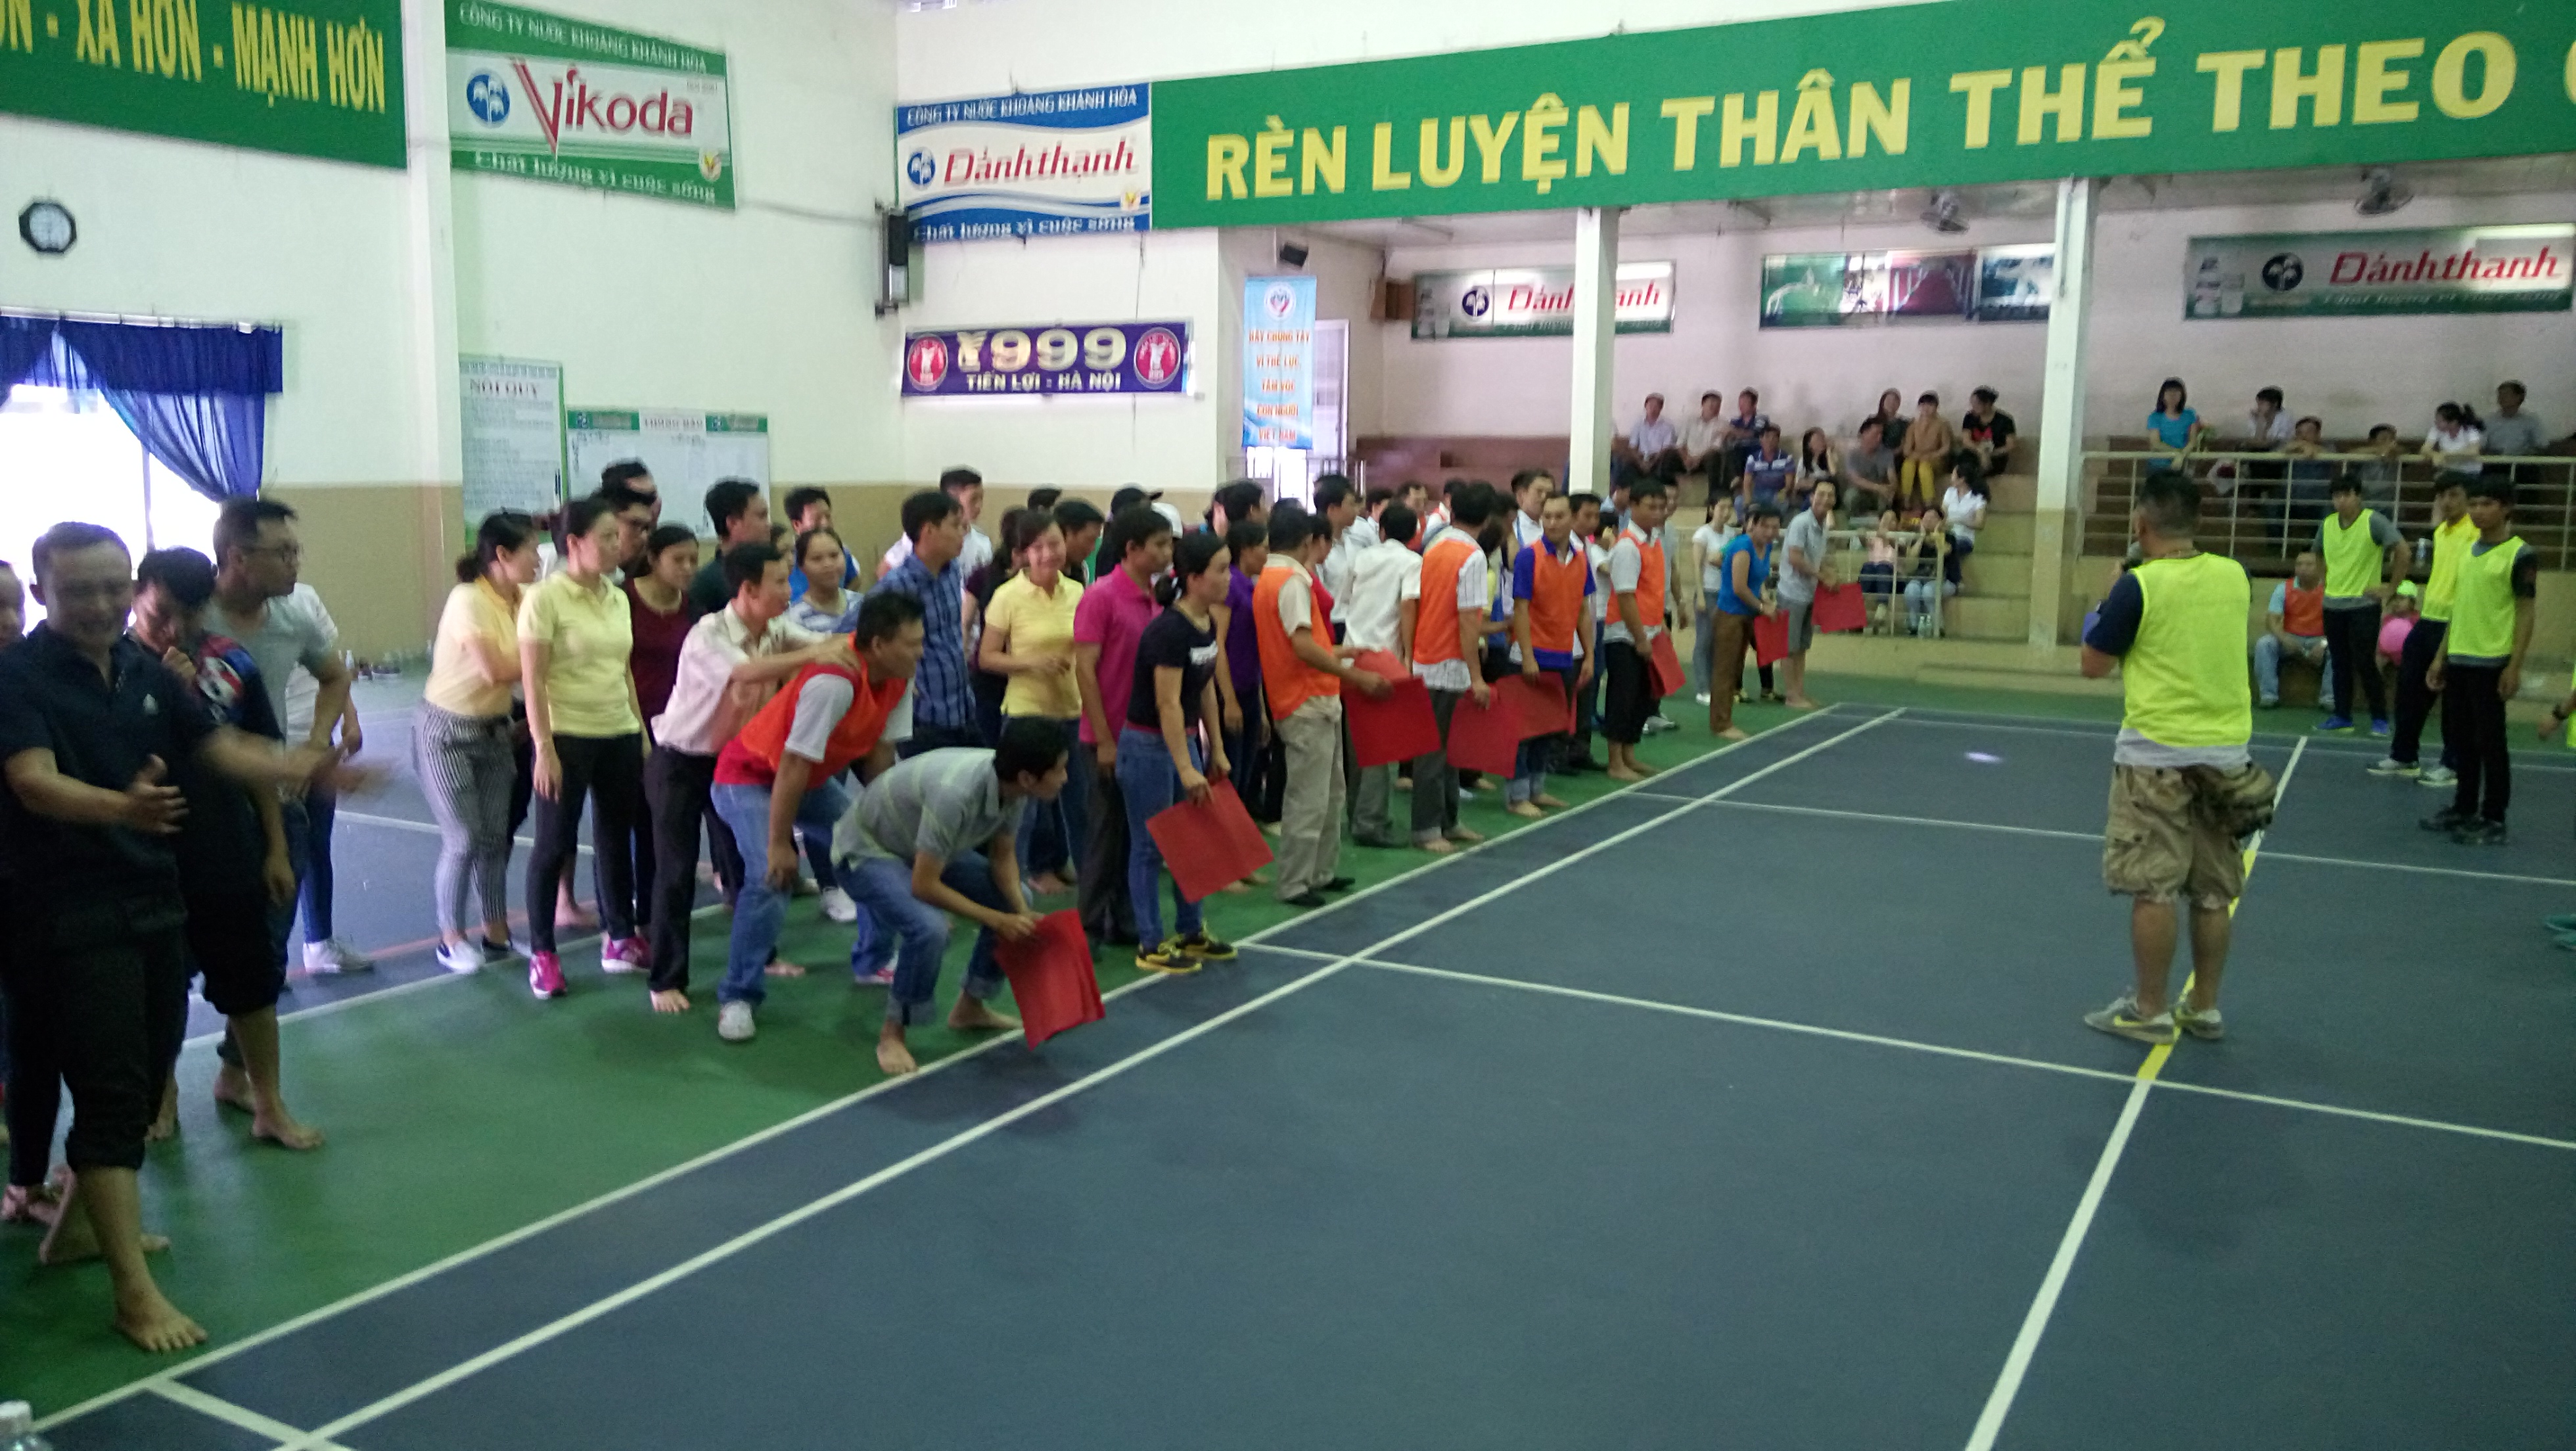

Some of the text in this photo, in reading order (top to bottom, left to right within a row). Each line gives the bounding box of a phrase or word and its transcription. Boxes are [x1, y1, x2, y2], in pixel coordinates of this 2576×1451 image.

[232, 1, 319, 108] MẠNH
[327, 15, 385, 114] HƠN
[459, 1, 503, 32] CÔNG
[507, 12, 524, 35] TY
[632, 37, 678, 68] KHÁNH
[511, 57, 694, 155] Vikoda
[907, 103, 942, 127] CÔNG
[946, 103, 960, 123] TY
[1058, 89, 1105, 112] KHÁNH
[1108, 85, 1138, 108] HÒA
[1206, 114, 1347, 201] RÈN
[1371, 92, 1630, 195] LUYỆN
[1661, 68, 1912, 171] THÂN
[1949, 16, 2166, 150] THỂ
[2196, 30, 2518, 132] THEO
[1059, 370, 1083, 390] HÀ
[1089, 368, 1121, 392] NỘI
